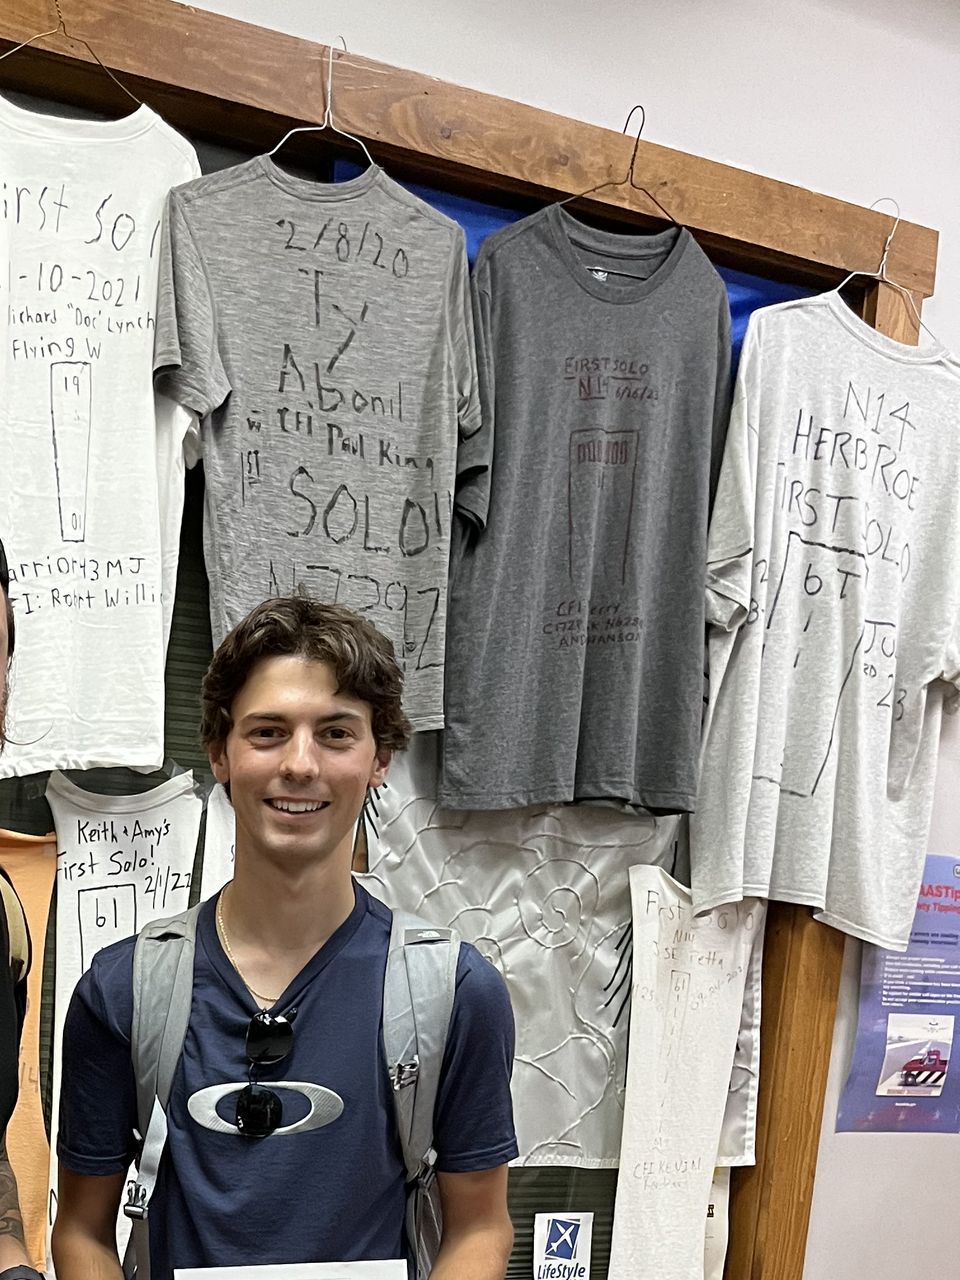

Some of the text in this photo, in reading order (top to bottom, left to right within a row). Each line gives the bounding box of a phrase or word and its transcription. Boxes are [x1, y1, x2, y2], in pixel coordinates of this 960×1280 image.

[276, 217, 409, 279] 2/8/20
[8, 304, 58, 328] ichard
[12, 335, 75, 361] Flying
[793, 408, 869, 470] HERB
[843, 381, 917, 452] N14
[778, 462, 859, 533] IRST
[78, 818, 171, 846] Keith Amy's
[107, 844, 156, 876] Solo!
